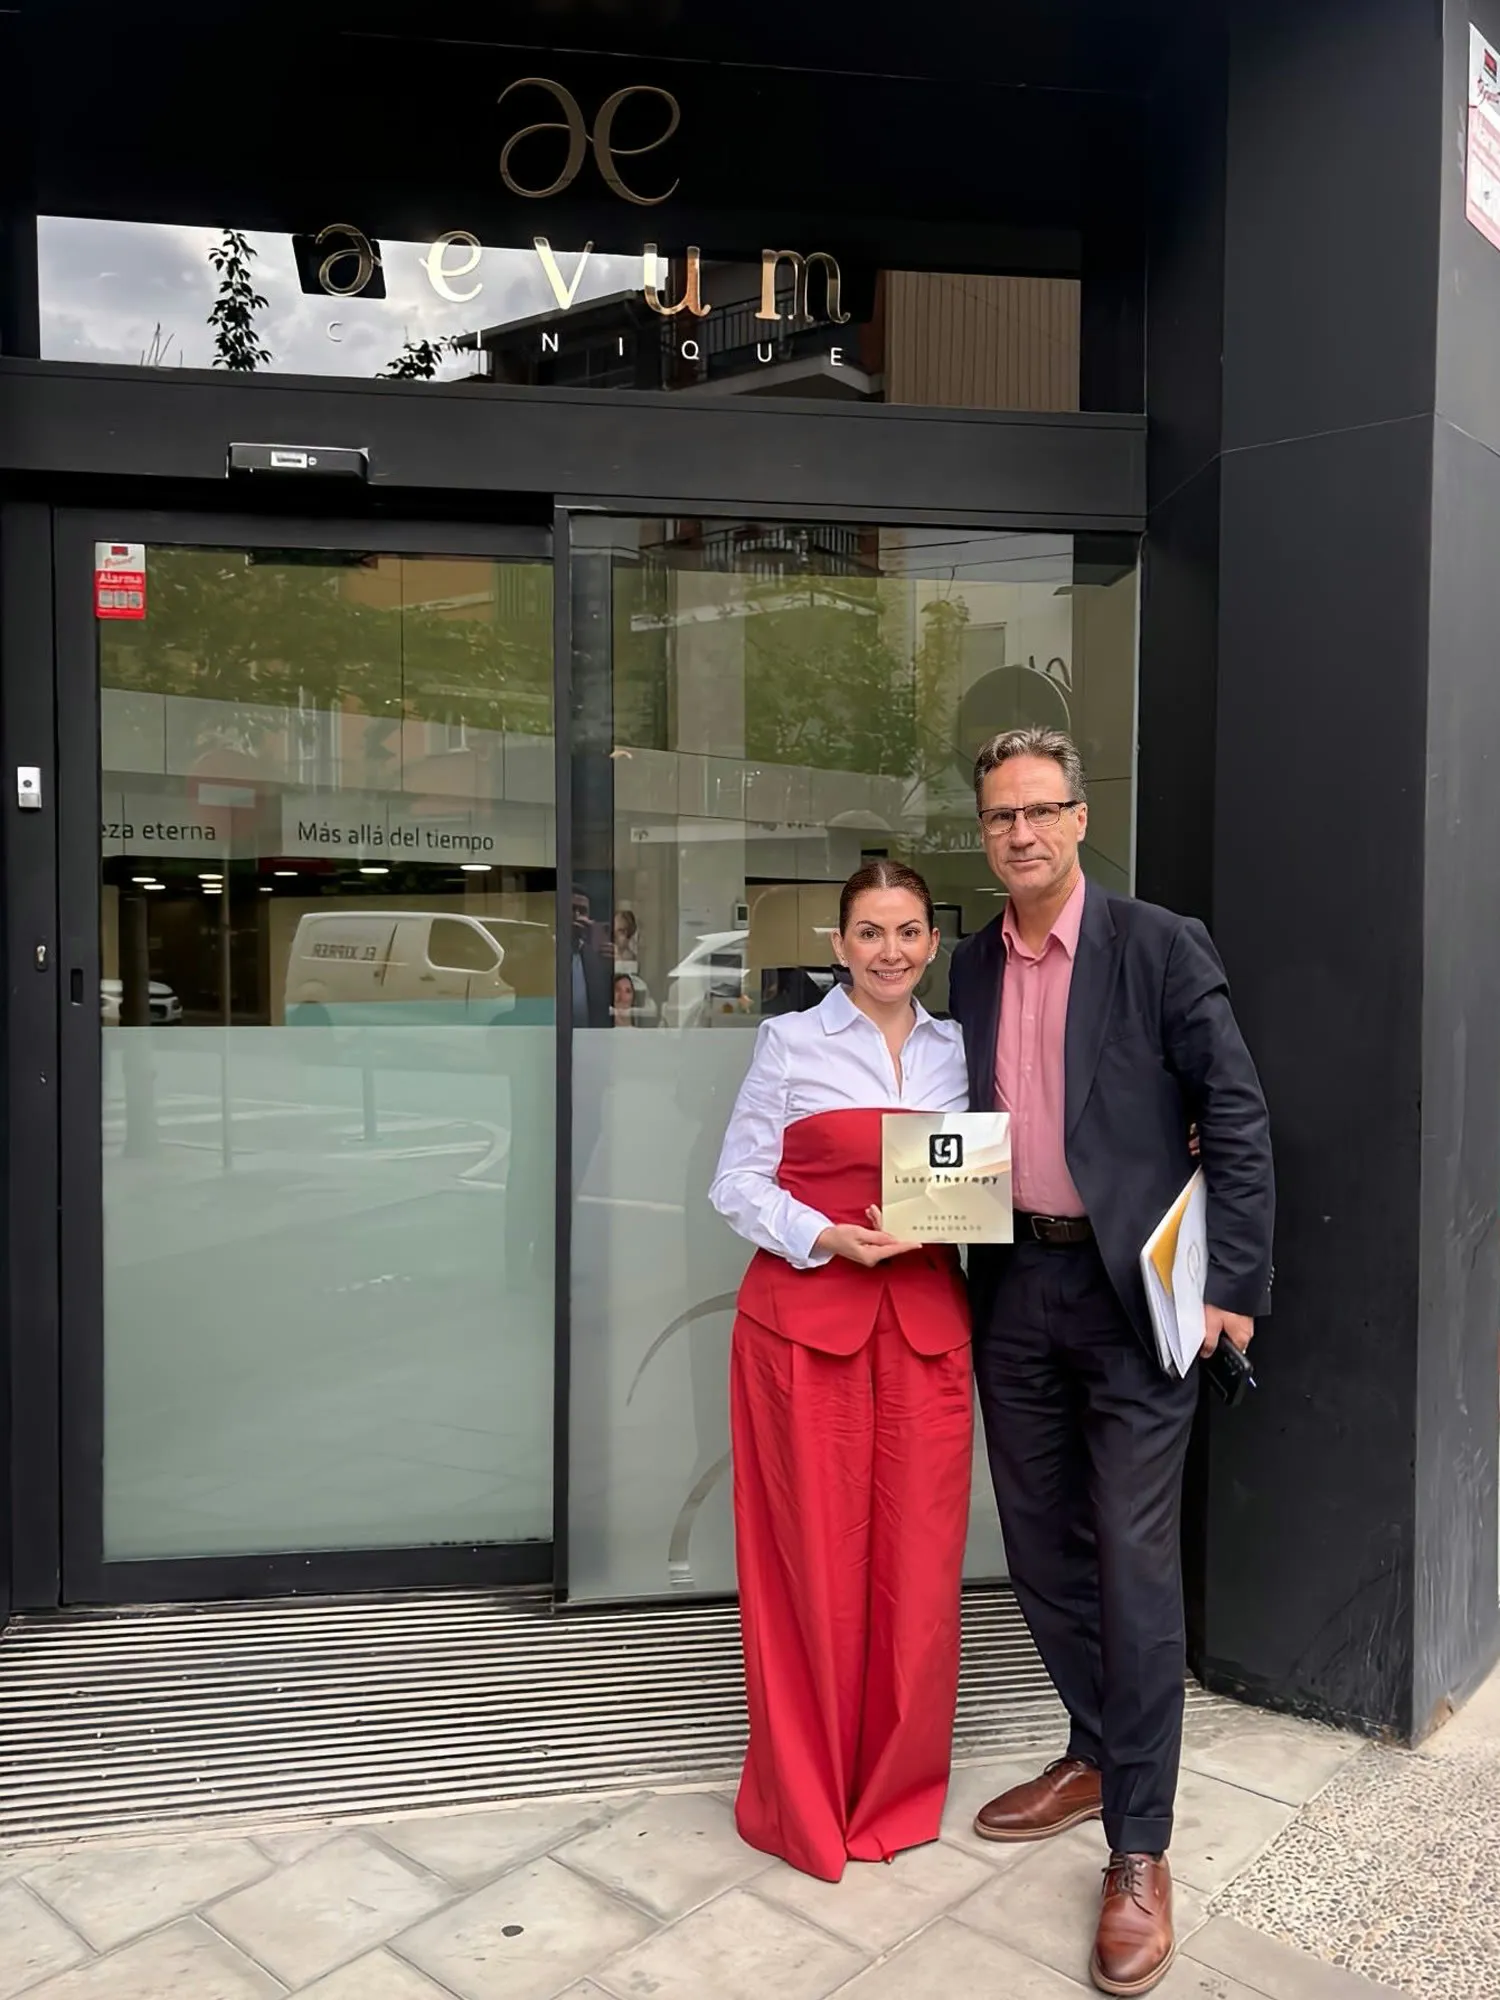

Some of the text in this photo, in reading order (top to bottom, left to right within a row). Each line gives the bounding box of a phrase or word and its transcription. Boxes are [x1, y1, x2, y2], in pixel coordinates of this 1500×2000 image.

[314, 222, 851, 325] aevum
[142, 822, 216, 841] eterna
[298, 821, 494, 855] Más allá del tiempo
